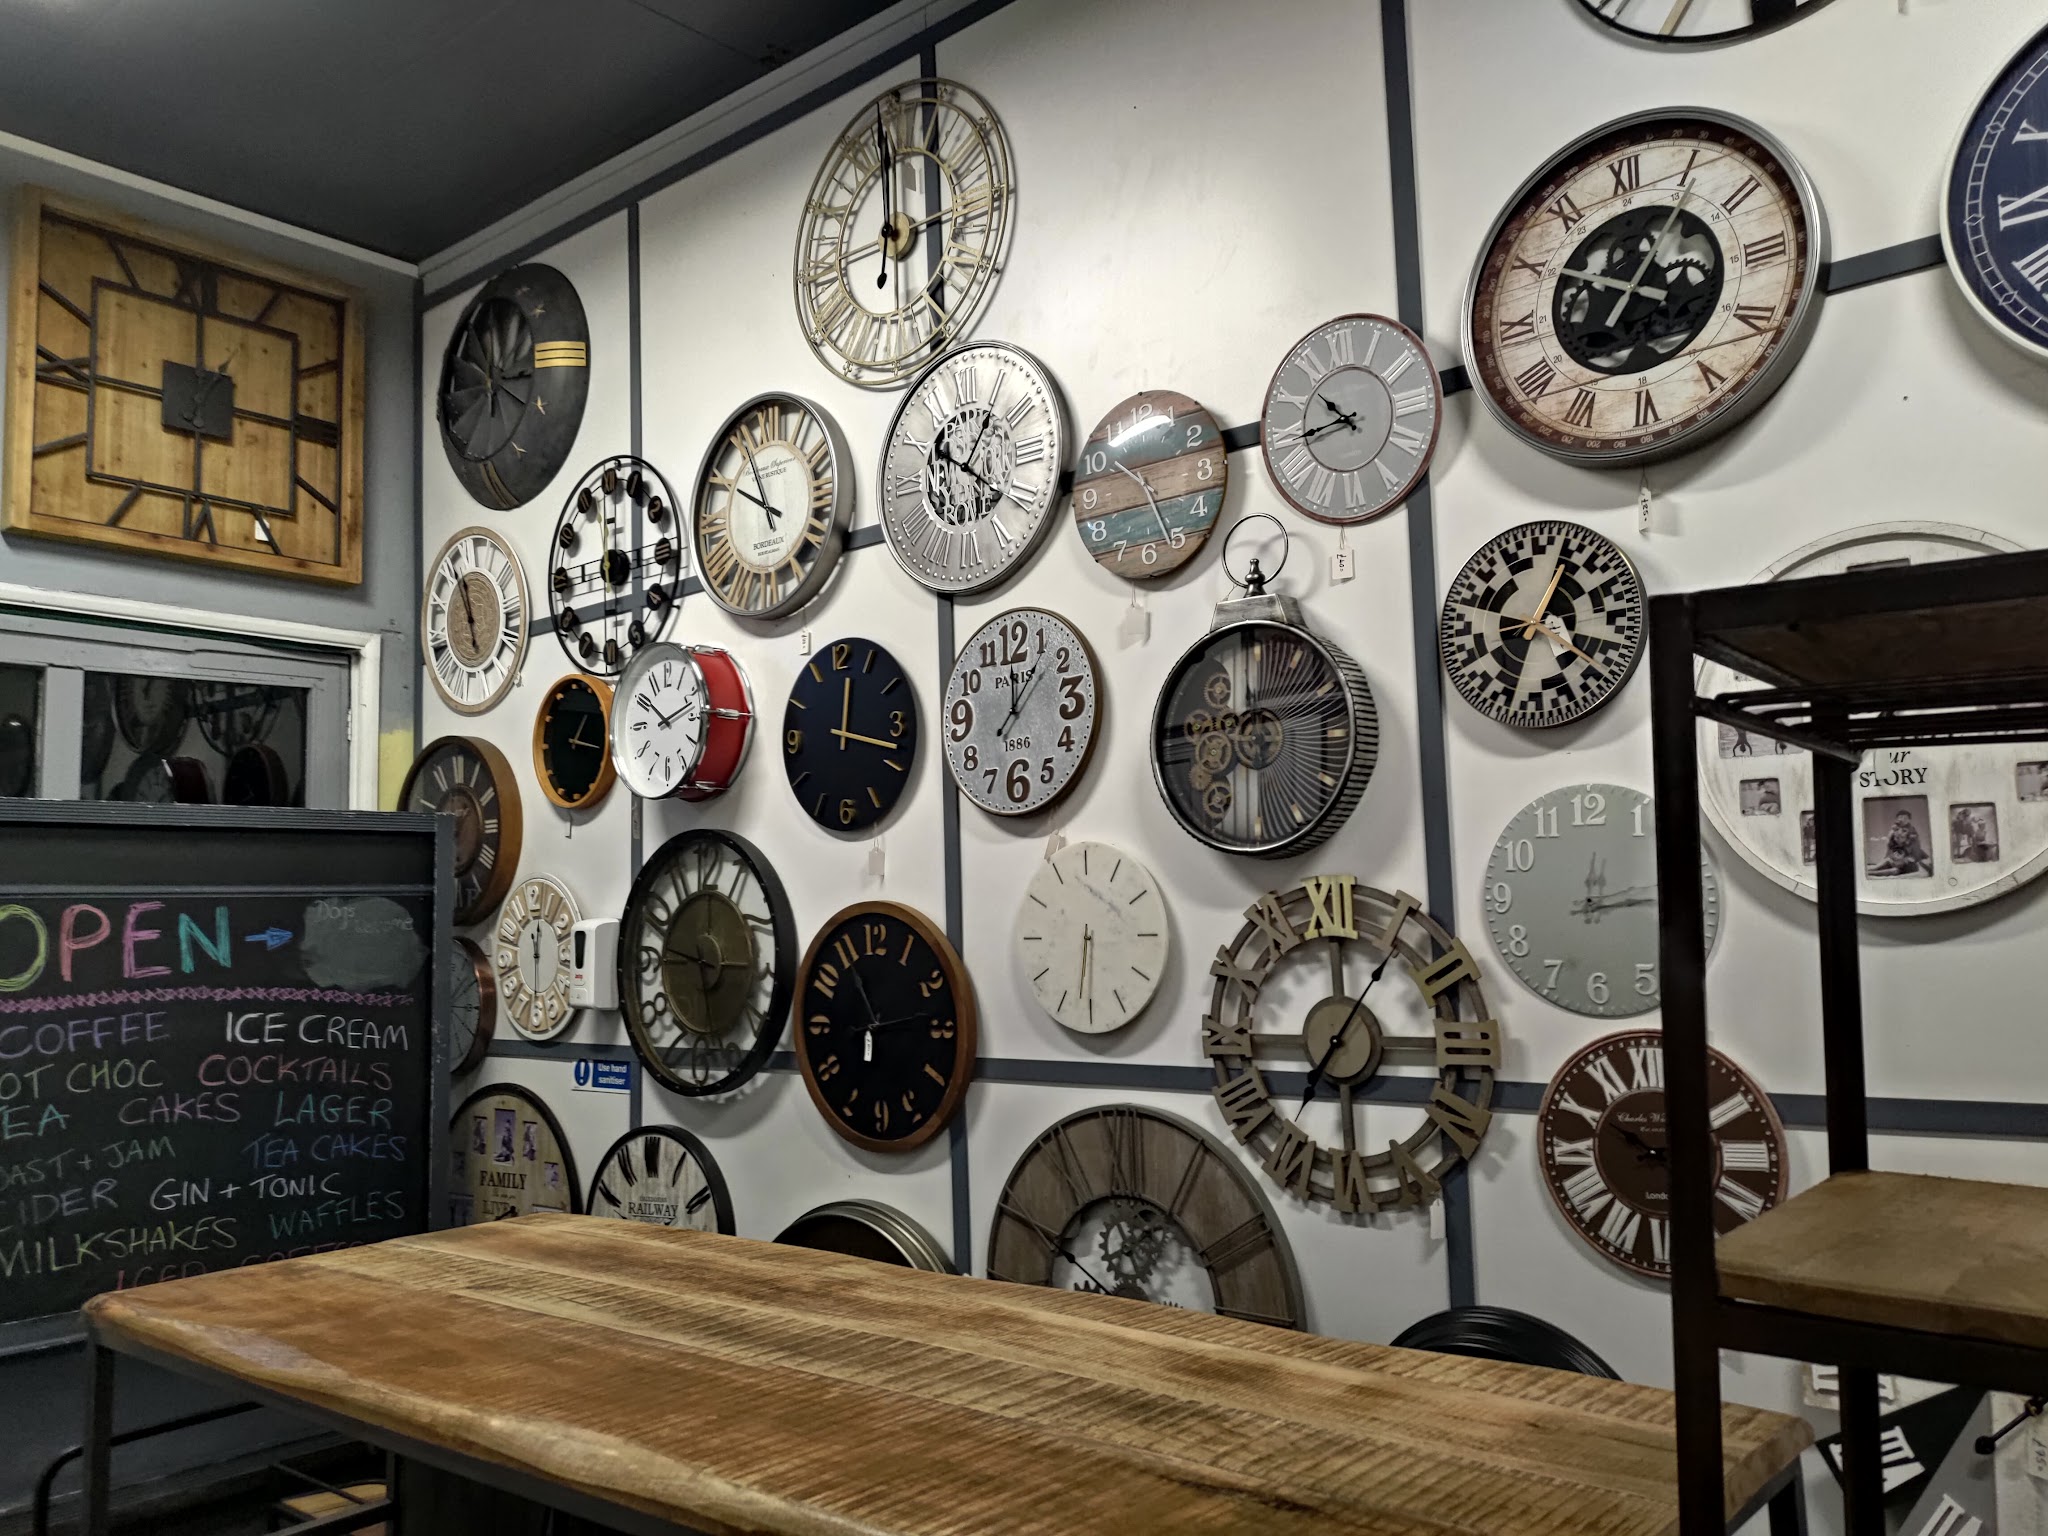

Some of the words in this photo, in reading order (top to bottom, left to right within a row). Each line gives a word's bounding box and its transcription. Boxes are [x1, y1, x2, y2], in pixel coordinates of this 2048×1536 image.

[1606, 154, 1640, 197] XII
[1677, 149, 1700, 187] I
[1622, 198, 1632, 207] 24
[1671, 192, 1680, 201] 13
[1721, 175, 1762, 215] II
[1546, 192, 1585, 234] XI
[1711, 212, 1720, 221] 14
[1577, 225, 1586, 235] 23
[1730, 255, 1739, 264] 15
[1743, 231, 1786, 267] III
[1510, 254, 1548, 279] X
[1547, 268, 1556, 276] 22
[1539, 315, 1547, 324] 21
[1722, 303, 1731, 312] 16
[1733, 303, 1776, 336] IV
[1500, 309, 1535, 344] IX
[1325, 329, 1355, 371] XII
[1553, 355, 1562, 363] 20
[1381, 349, 1415, 386] II
[1514, 356, 1556, 405] VIII
[1638, 376, 1647, 384] 18
[1696, 360, 1728, 394] V
[955, 366, 978, 408] XII
[1131, 404, 1152, 423] 12
[1392, 386, 1428, 417] III
[1562, 388, 1596, 428] VII
[1633, 389, 1662, 427] VI
[1167, 406, 1176, 427] 1
[1106, 421, 1123, 444] 11
[1187, 425, 1202, 448] 2
[1084, 451, 1106, 475] 10
[1197, 458, 1212, 480] 3
[651, 501, 661, 519] 2
[943, 496, 992, 527] ROME
[1083, 489, 1097, 509] 9
[1190, 495, 1207, 517] 4
[753, 536, 784, 550] BORDEAUX
[1092, 521, 1107, 541] 8
[1171, 527, 1186, 549] 5
[1113, 540, 1126, 562] 7
[1142, 544, 1156, 565] 6
[631, 625, 641, 644] 5
[999, 620, 1028, 665] 12
[1036, 628, 1045, 654] 1
[832, 644, 849, 670] 12
[980, 641, 997, 667] 11
[1057, 647, 1070, 673] 2
[649, 672, 660, 696] 11
[664, 662, 671, 688] 12
[961, 669, 981, 696] 10
[995, 670, 1033, 689] PARIS
[637, 693, 651, 712] 10
[1058, 675, 1085, 719] 3
[633, 722, 648, 731] 9
[889, 711, 904, 737] 3
[951, 700, 973, 742] 9
[787, 729, 799, 754] 9
[1004, 737, 1030, 752] 1886
[1058, 726, 1075, 752] 4
[665, 756, 670, 781] 6
[963, 745, 978, 771] 8
[1041, 757, 1054, 784] 5
[983, 769, 998, 793] 7
[1007, 759, 1030, 802] 6
[840, 799, 855, 824] 6
[1534, 806, 1560, 837] 11
[1571, 793, 1606, 826] 12
[1631, 805, 1645, 837] 1
[1504, 840, 1534, 872] 10
[511, 896, 525, 921] 11
[1301, 875, 1359, 940] XII
[1493, 883, 1511, 914] 9
[501, 918, 516, 941] 10
[554, 914, 568, 935] 2
[0, 901, 232, 991] OPEN
[834, 933, 859, 969] 11
[863, 924, 887, 955] 12
[1509, 925, 1530, 956] 8
[498, 951, 512, 968] 9
[1409, 937, 1482, 1008] II
[503, 976, 517, 997] 8
[814, 963, 839, 999] 10
[918, 970, 943, 997] 2
[1210, 945, 1268, 1004] X
[1544, 960, 1563, 988] 7
[1635, 963, 1658, 995] 5
[1587, 972, 1609, 1004] 6
[532, 1001, 542, 1026] 6
[0, 1012, 169, 1058] COFFEE
[226, 1012, 288, 1044] ICE
[299, 1014, 408, 1050] CREAM
[1432, 1019, 1501, 1069] III
[66, 1059, 163, 1093] CHOC
[198, 1054, 392, 1090] COCKTAILS
[597, 1063, 610, 1072] Use
[611, 1064, 627, 1073] hand
[119, 1092, 240, 1124] CAKES
[274, 1091, 392, 1129] LAGER
[0, 1104, 70, 1140] EA
[102, 1136, 176, 1168] JAM
[242, 1133, 298, 1169] TEA
[311, 1133, 407, 1161] CAKES
[1720, 1140, 1770, 1172] III
[151, 1178, 209, 1210] GIN
[250, 1172, 341, 1198] TONIC
[480, 1170, 527, 1190] FAMILY
[0, 1178, 118, 1233] IDER
[270, 1191, 404, 1240] WAFFLES
[628, 1201, 679, 1217] RAILWAY
[0, 1216, 238, 1277] MILKSHAKES
